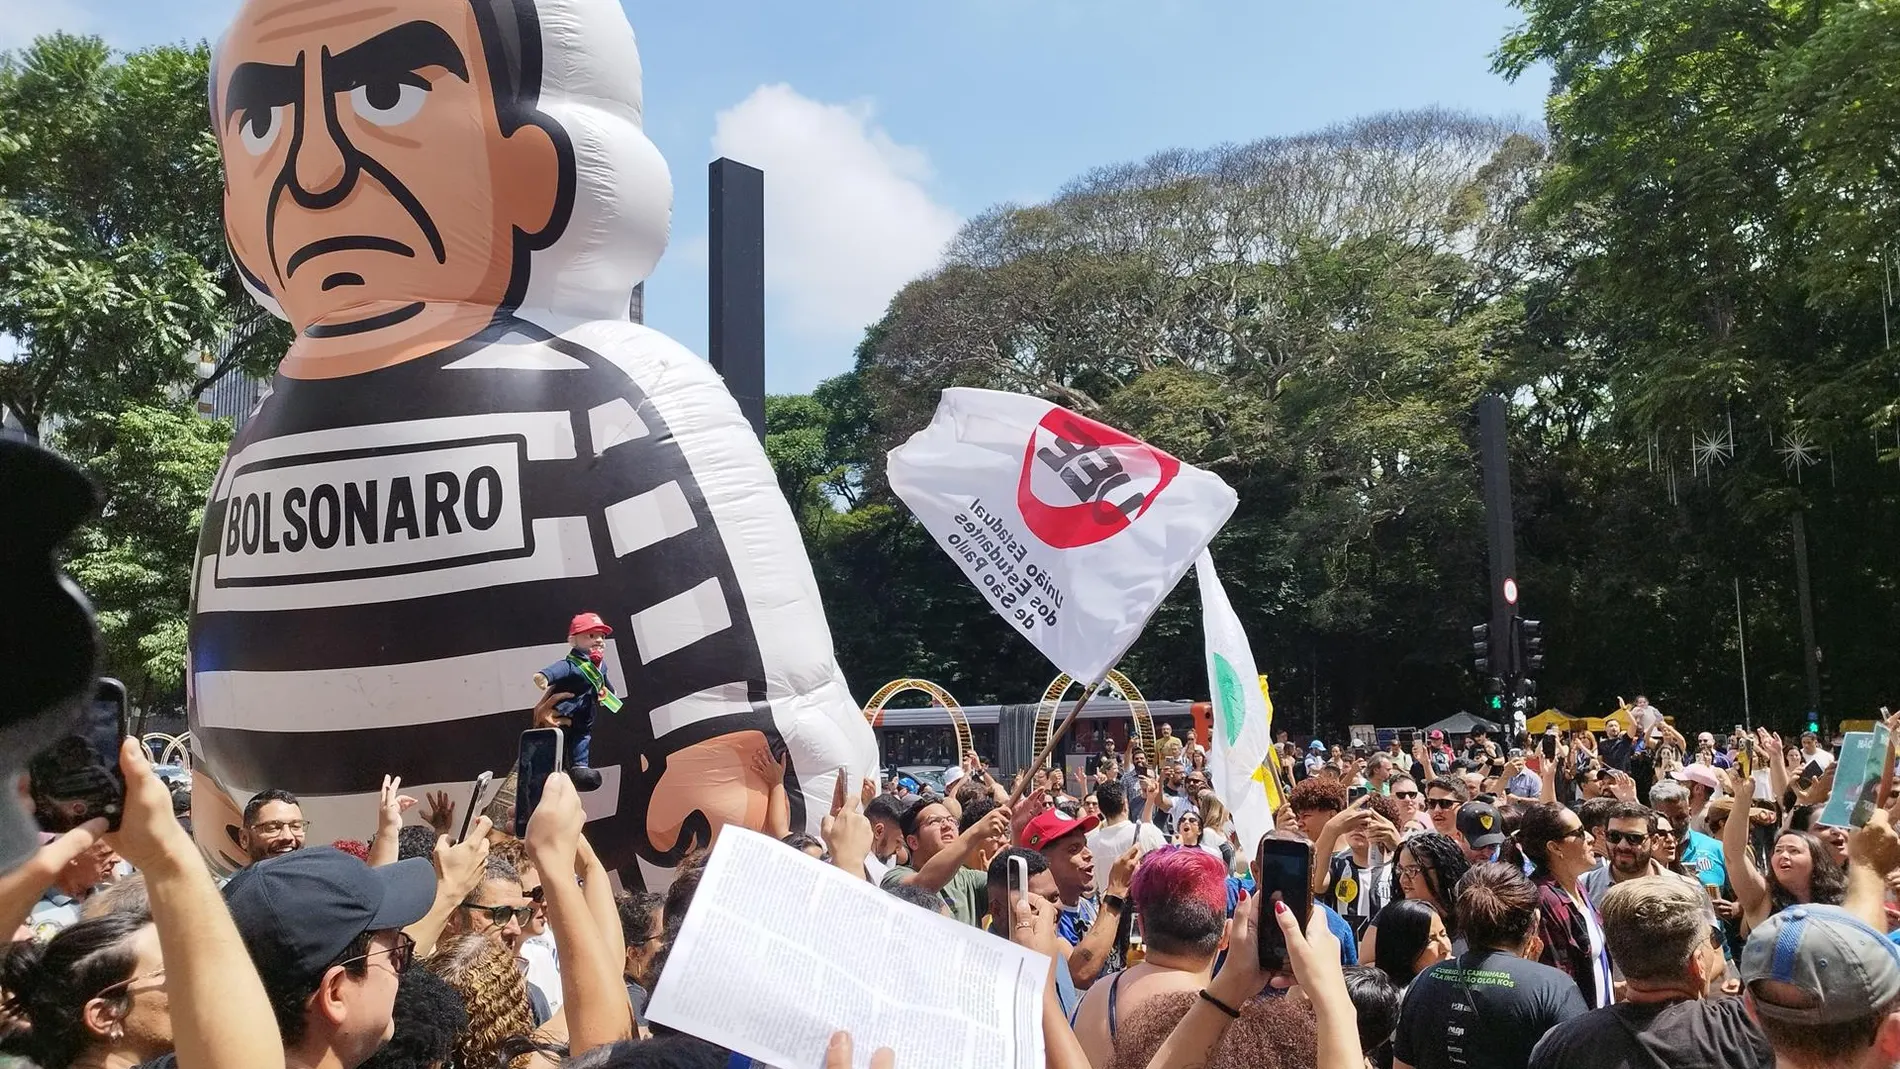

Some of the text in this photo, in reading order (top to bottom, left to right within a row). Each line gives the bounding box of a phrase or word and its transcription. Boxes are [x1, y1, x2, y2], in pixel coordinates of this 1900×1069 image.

[226, 466, 502, 556] BOLSONARO
[1429, 972, 1443, 980] PELA
[1444, 973, 1477, 984] INCLÃO
[1497, 978, 1515, 988] KOS
[1435, 967, 1461, 976] CORRID
[1467, 969, 1511, 979] CAMINHADA
